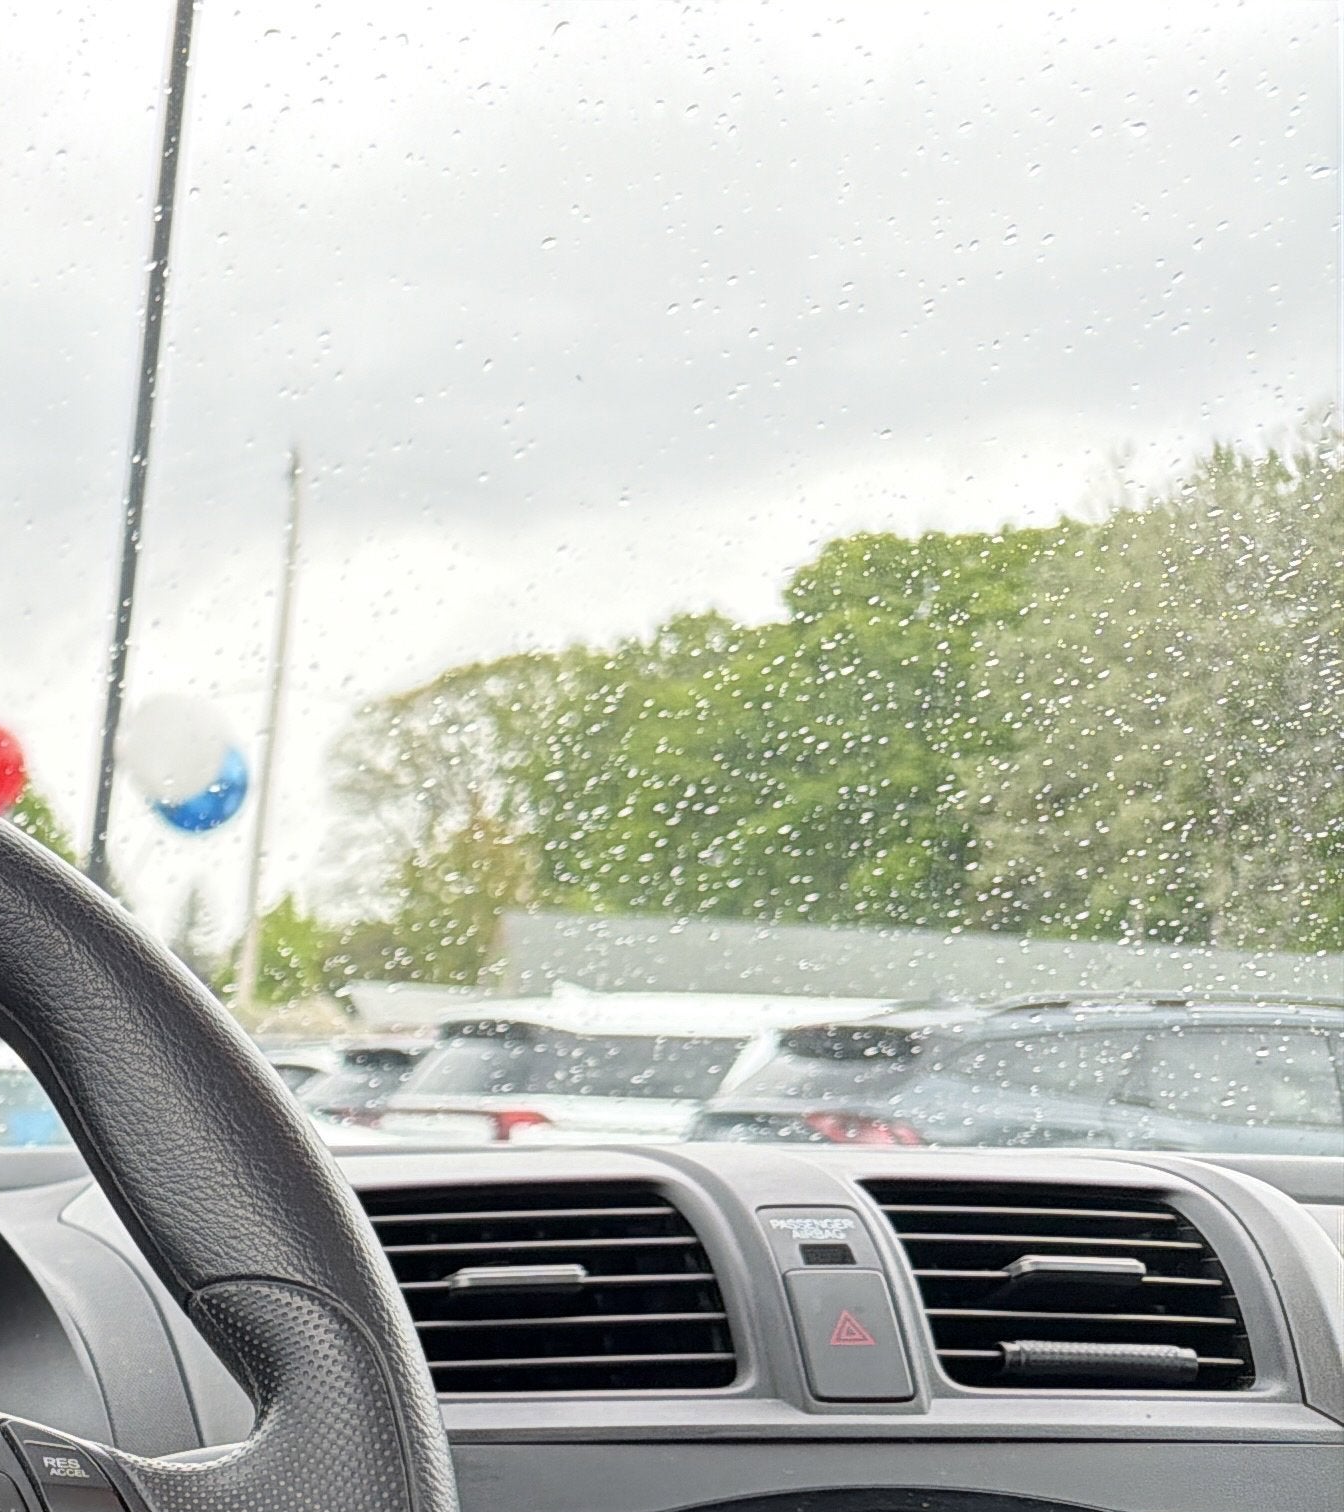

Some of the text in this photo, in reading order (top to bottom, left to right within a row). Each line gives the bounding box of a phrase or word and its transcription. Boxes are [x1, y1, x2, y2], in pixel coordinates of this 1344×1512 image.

[769, 1218, 855, 1230] PASSENGER
[792, 1228, 846, 1240] AIRBAG
[43, 1456, 81, 1468] RES
[49, 1467, 90, 1478] ACCEL
